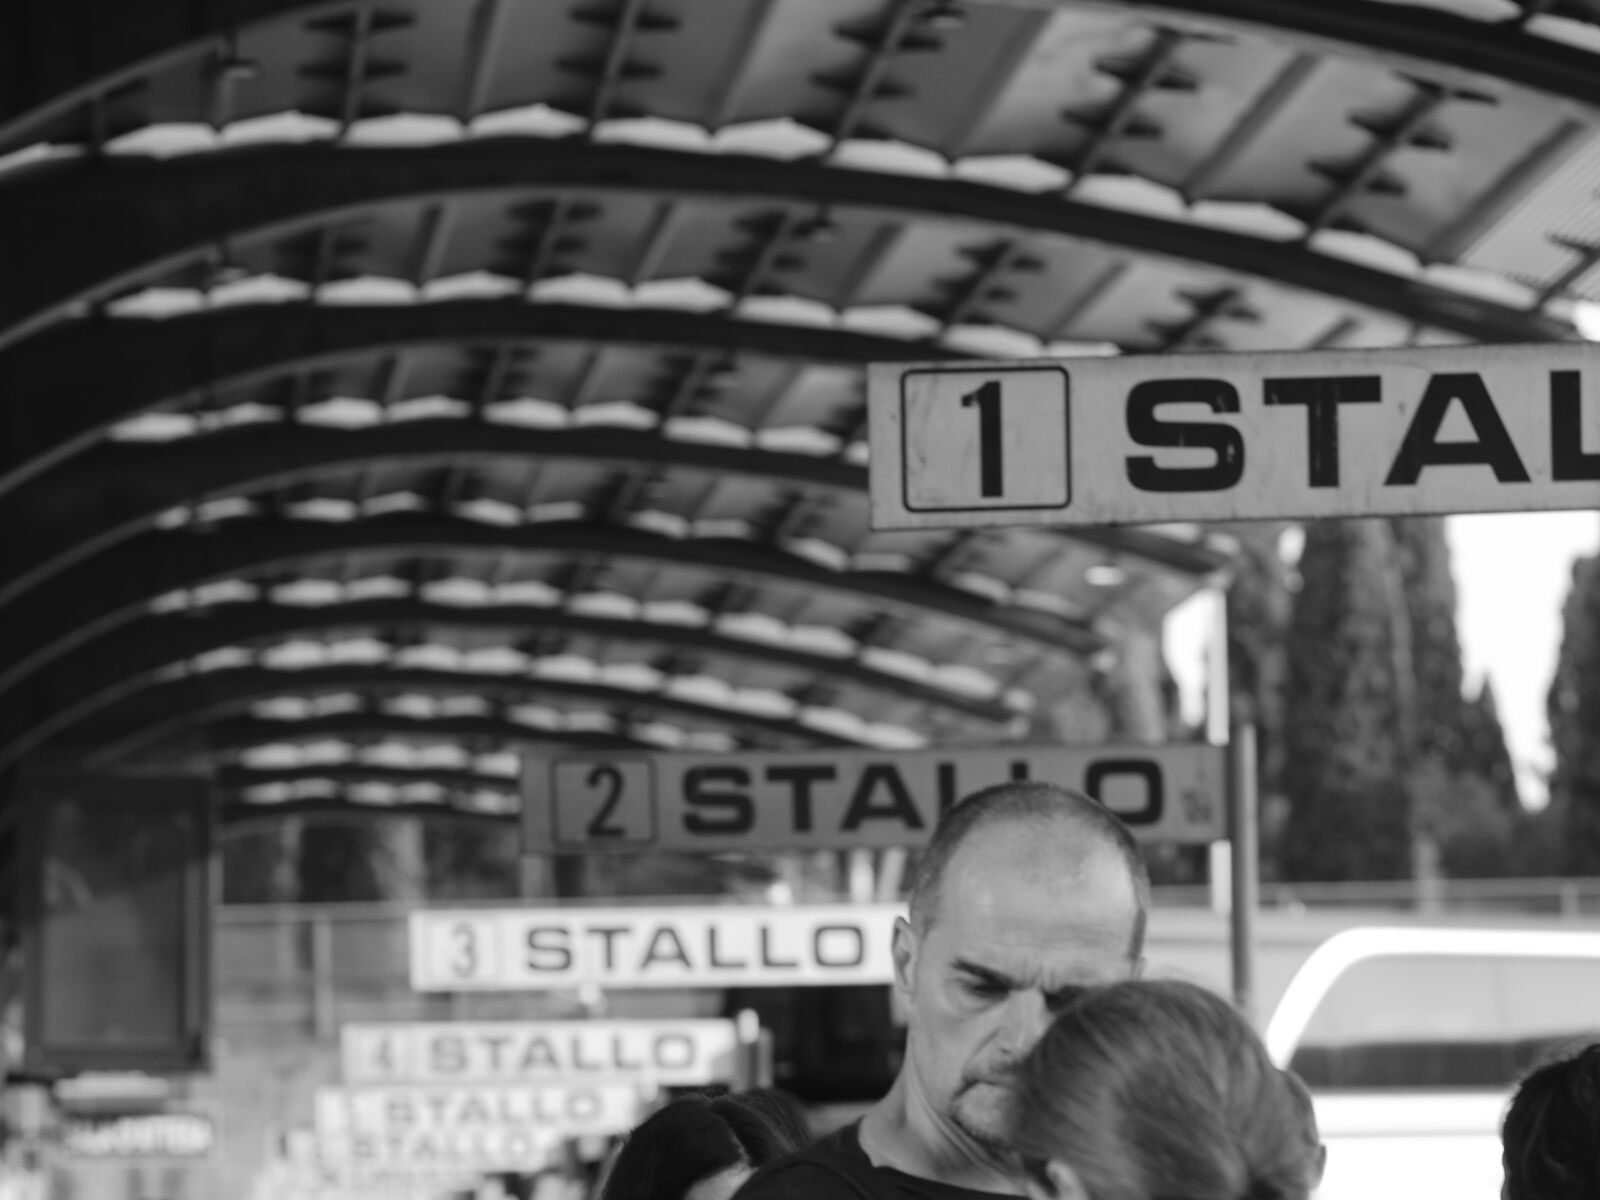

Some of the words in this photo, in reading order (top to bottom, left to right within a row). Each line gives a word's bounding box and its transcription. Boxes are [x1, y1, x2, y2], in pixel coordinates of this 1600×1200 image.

[961, 380, 1003, 497] 1
[1125, 369, 1600, 493] STAL
[586, 763, 626, 838] 2
[680, 759, 1163, 836] STAO
[449, 922, 476, 979] 3
[526, 924, 864, 973] STALLO
[428, 1032, 697, 1073] STALLO
[384, 1089, 601, 1126] STALLO
